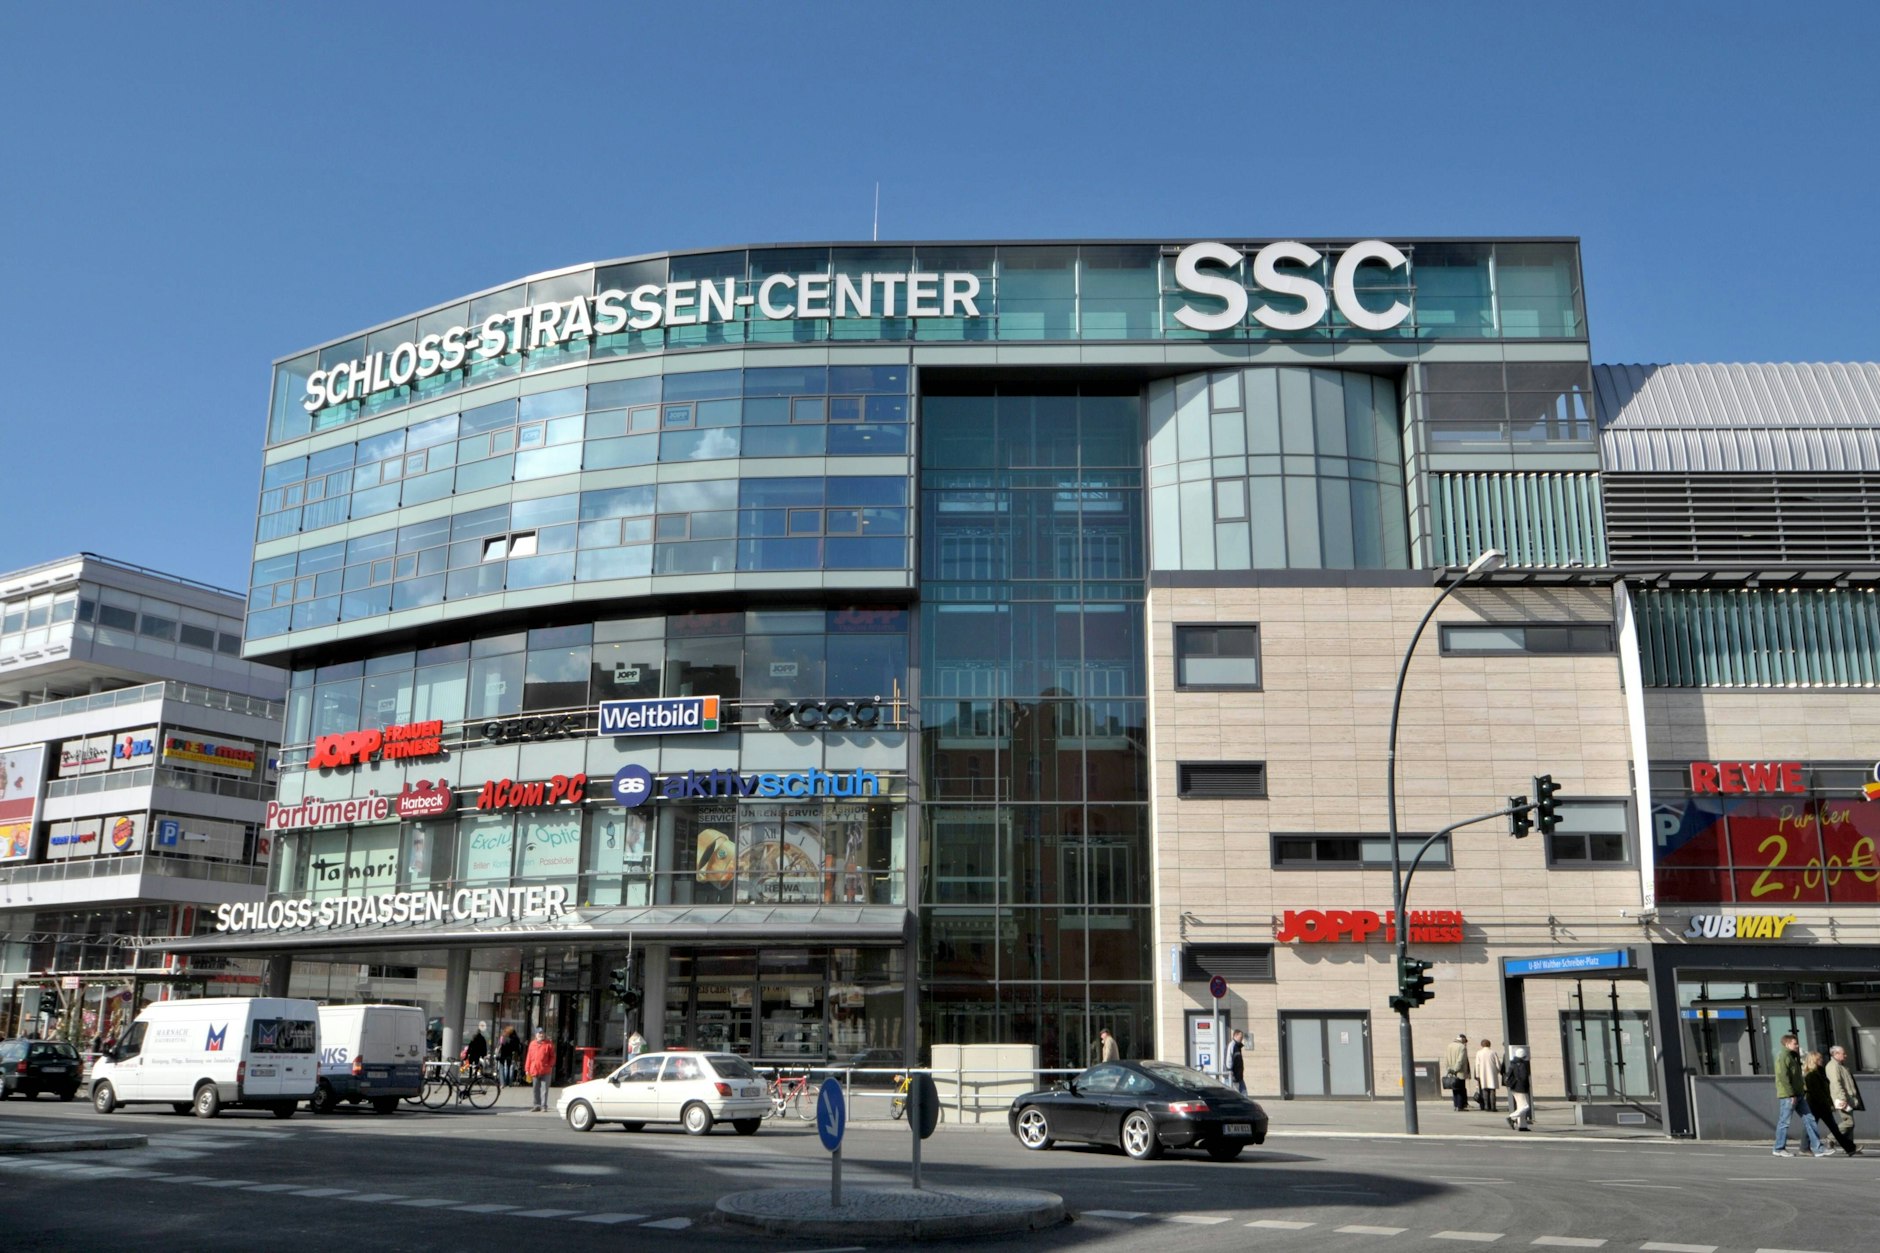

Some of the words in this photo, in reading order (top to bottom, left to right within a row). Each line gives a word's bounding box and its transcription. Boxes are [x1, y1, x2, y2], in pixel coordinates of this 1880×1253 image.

[1173, 240, 1411, 331] SSC
[303, 272, 981, 412] SCHLOSS-STRASSEN-CENTER
[616, 669, 638, 680] JOPP
[772, 664, 796, 673] JOPP
[385, 720, 443, 742] FRAUEN
[603, 703, 700, 730] Weltbild
[309, 728, 382, 768] JOPP
[383, 738, 441, 759] FITNESS
[550, 773, 587, 804] PC
[662, 766, 880, 799] aktivschuh
[1690, 762, 1806, 793] REWE
[265, 789, 388, 829] Parfümerie
[401, 793, 443, 810] Harbeck
[699, 814, 736, 822] SERVICE
[1654, 813, 1681, 847] P
[1779, 801, 1850, 833] Parken
[163, 825, 176, 844] P
[216, 885, 568, 932] SCHLOSS-STRASSEN-CENTER
[1386, 910, 1462, 926] FAUEN
[1276, 909, 1380, 943] JOPP
[1683, 914, 1797, 939] SUBWAY
[1542, 956, 1600, 970] Walther-Schreiber-Platz
